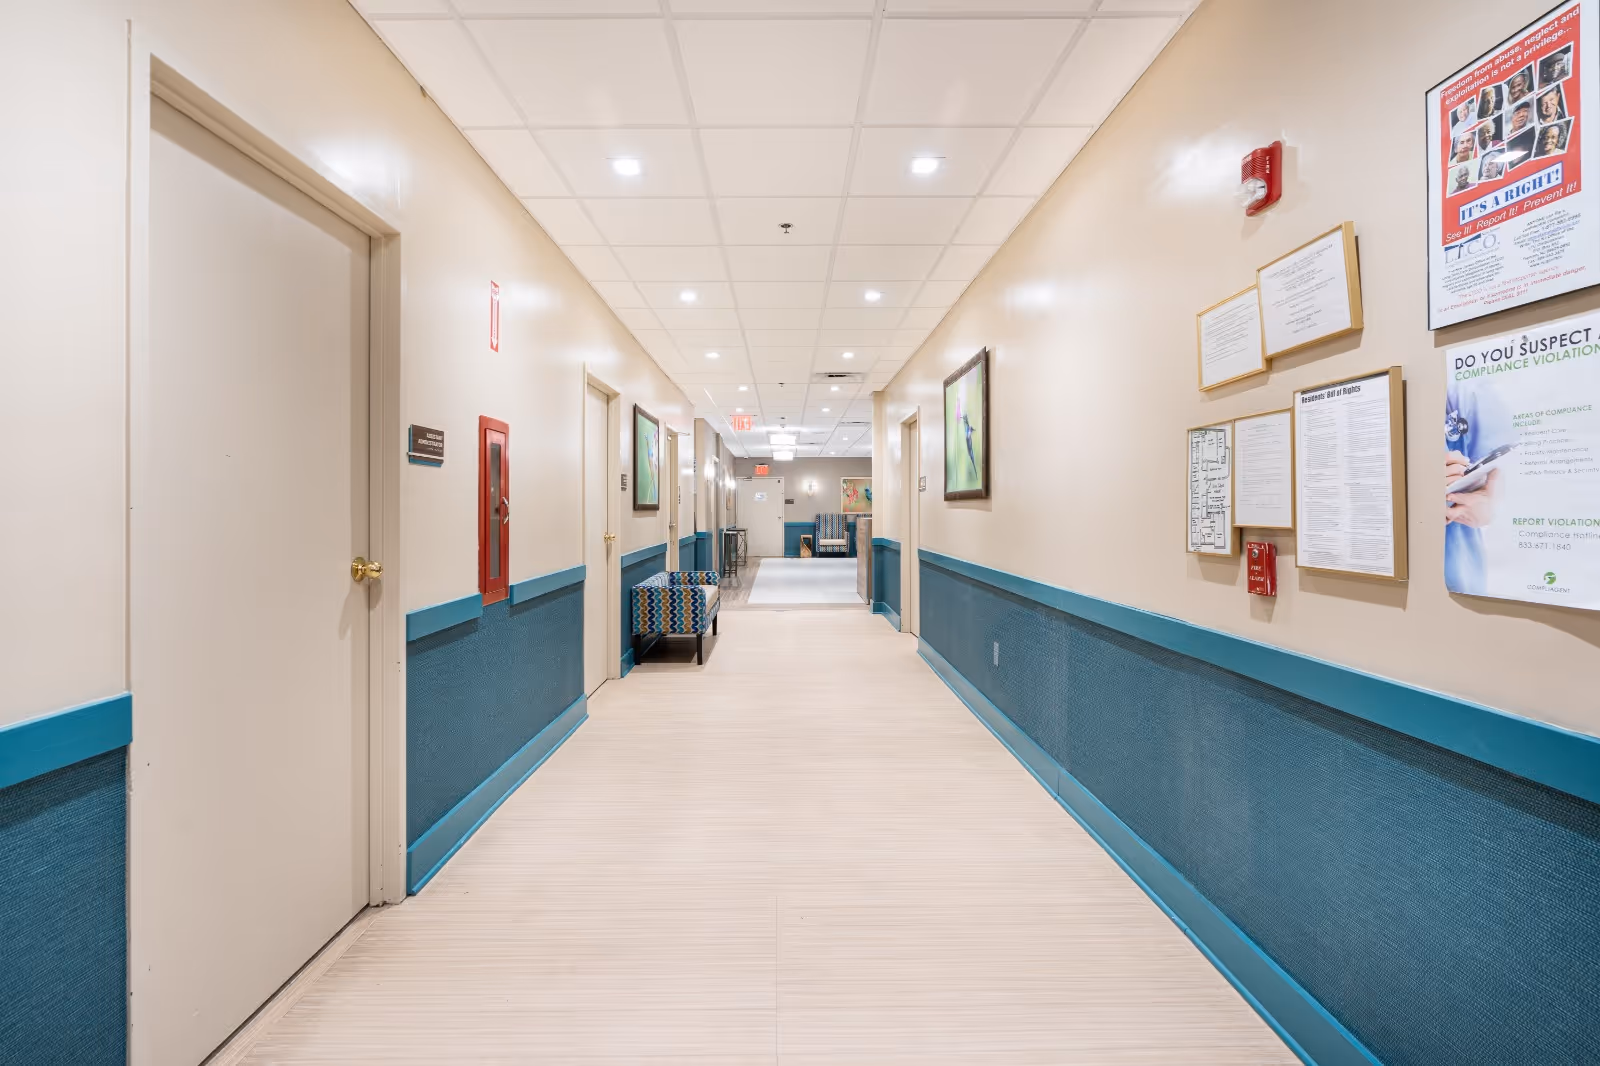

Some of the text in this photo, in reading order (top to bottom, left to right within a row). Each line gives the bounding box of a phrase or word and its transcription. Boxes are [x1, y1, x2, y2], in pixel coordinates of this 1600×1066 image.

[1440, 6, 1580, 98] Freedom from abuse, neglect and
[1445, 74, 1489, 106] exploitation
[1491, 69, 1498, 78] is
[1500, 58, 1514, 72] not
[1461, 168, 1560, 221] IT'S A RIGHT!
[1446, 231, 1462, 242] See
[1464, 226, 1472, 236] It!
[1476, 211, 1506, 230] Report
[1509, 206, 1518, 216] It!
[1523, 189, 1563, 211] Prevent
[1566, 182, 1577, 194] It!
[1455, 354, 1476, 370] DO
[1481, 345, 1514, 364] YOU
[1520, 328, 1592, 356] SUSPECT
[1455, 358, 1529, 381] COMPLIANCE
[1342, 386, 1361, 396] Rights
[1512, 412, 1534, 420] AREAS
[1546, 404, 1592, 416] COMPLIANCE
[1512, 518, 1544, 526] REPORT
[1519, 531, 1570, 539] Compliance
